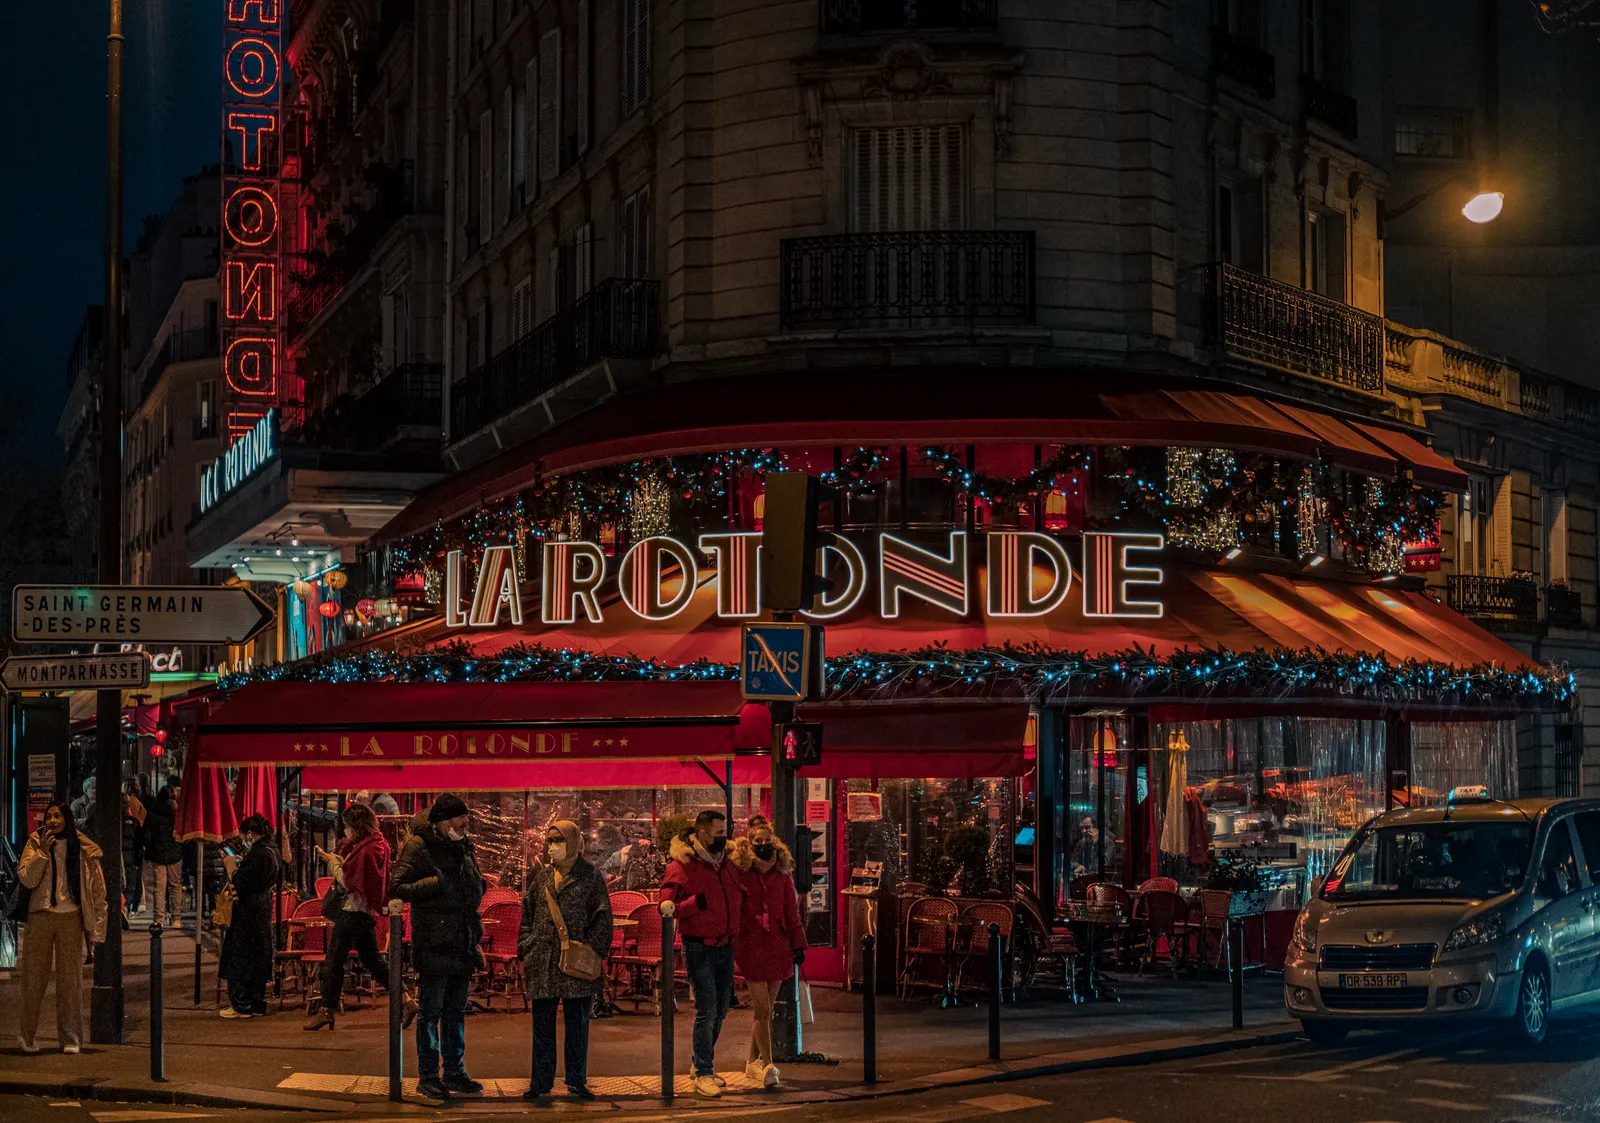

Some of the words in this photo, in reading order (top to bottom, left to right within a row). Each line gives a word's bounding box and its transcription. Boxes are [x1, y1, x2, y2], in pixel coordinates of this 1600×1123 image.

[224, 408, 275, 492] ROTONDE
[446, 545, 523, 627] LA
[23, 595, 94, 612] SAINT
[100, 595, 203, 613] GERMAIN
[17, 662, 139, 682] MONTPARNASSE
[748, 650, 800, 673] TAXIS
[339, 735, 385, 756] LA
[413, 732, 580, 755] ROTONDE
